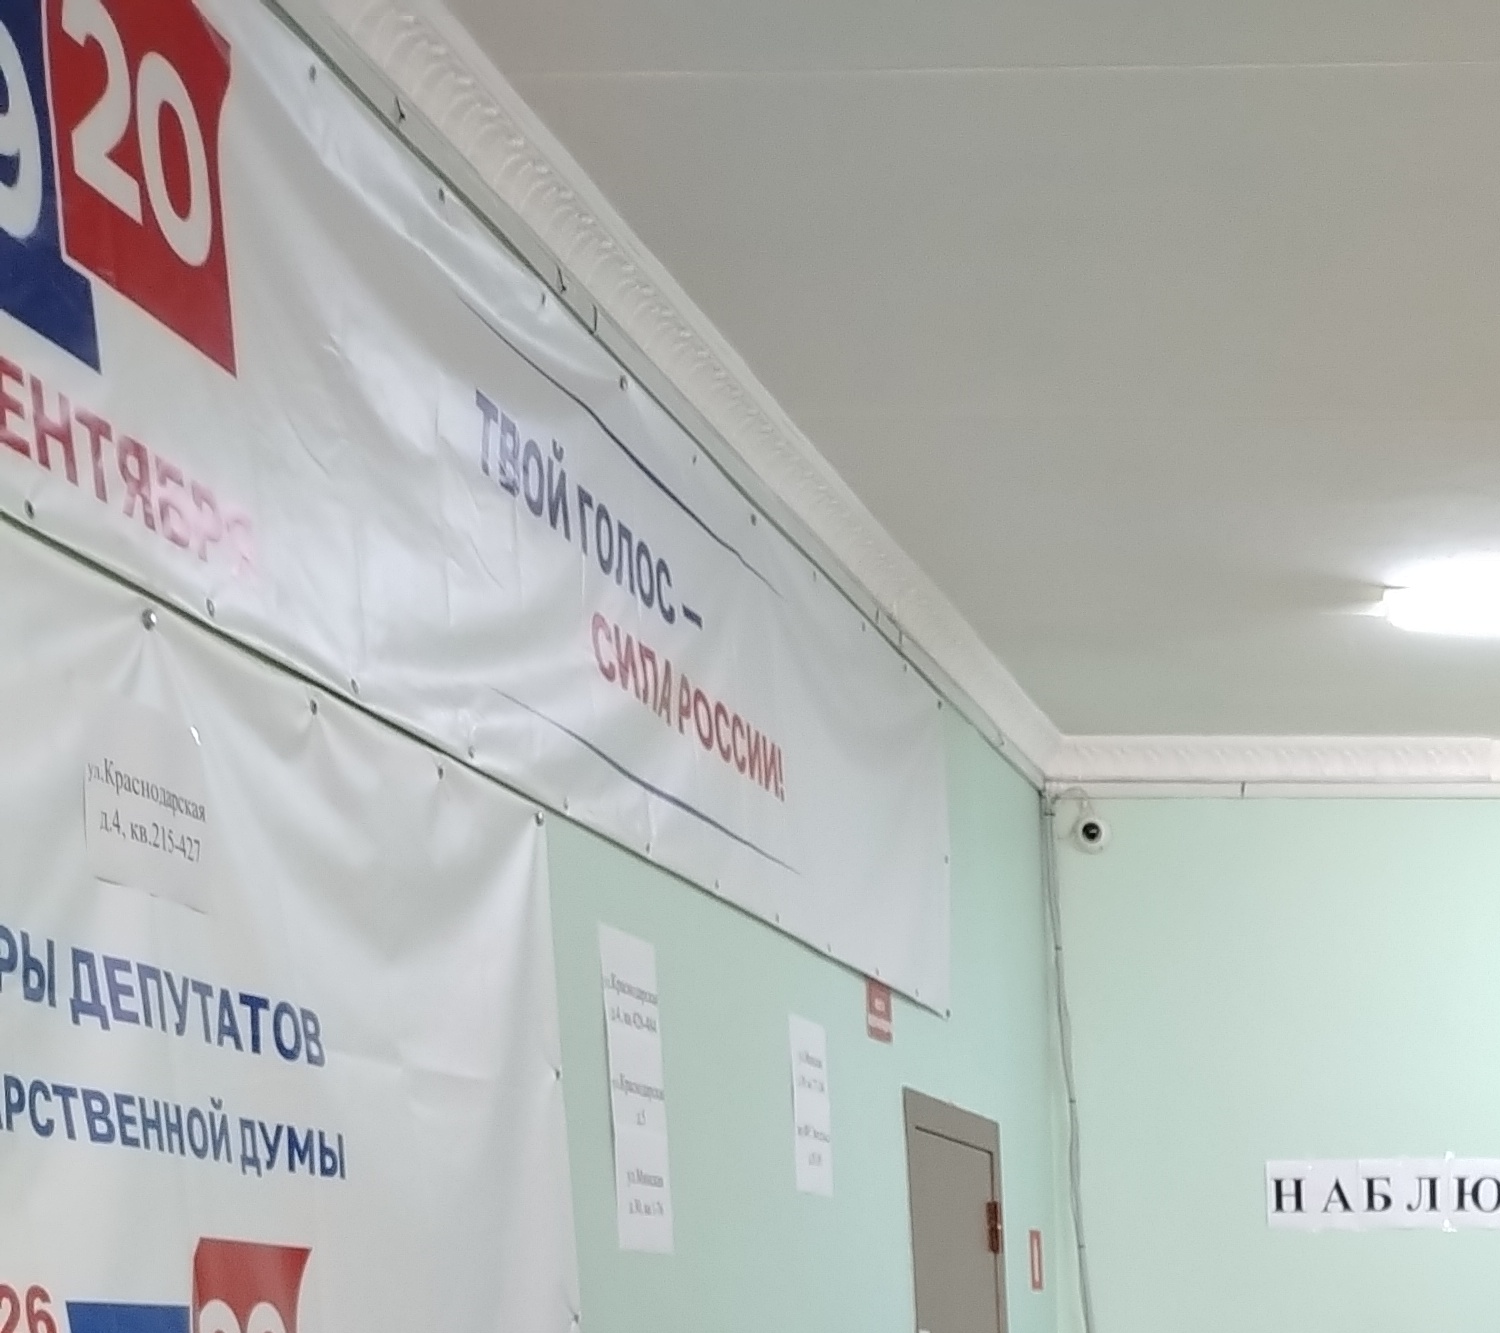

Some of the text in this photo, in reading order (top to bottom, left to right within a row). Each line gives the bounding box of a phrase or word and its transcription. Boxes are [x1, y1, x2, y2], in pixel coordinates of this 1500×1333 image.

[62, 0, 213, 267] 20
[475, 388, 571, 541] ТВОЙ
[577, 484, 676, 625] ГОЛОС
[591, 611, 785, 802] СИЛА РОССИИ!
[87, 757, 206, 822] ул.Краснодарская
[130, 822, 201, 863] кв.215-427
[69, 946, 326, 1068] ДЕПУТАТОВ
[0, 1073, 347, 1180] РСТВЕННОЙ ДУМЫ
